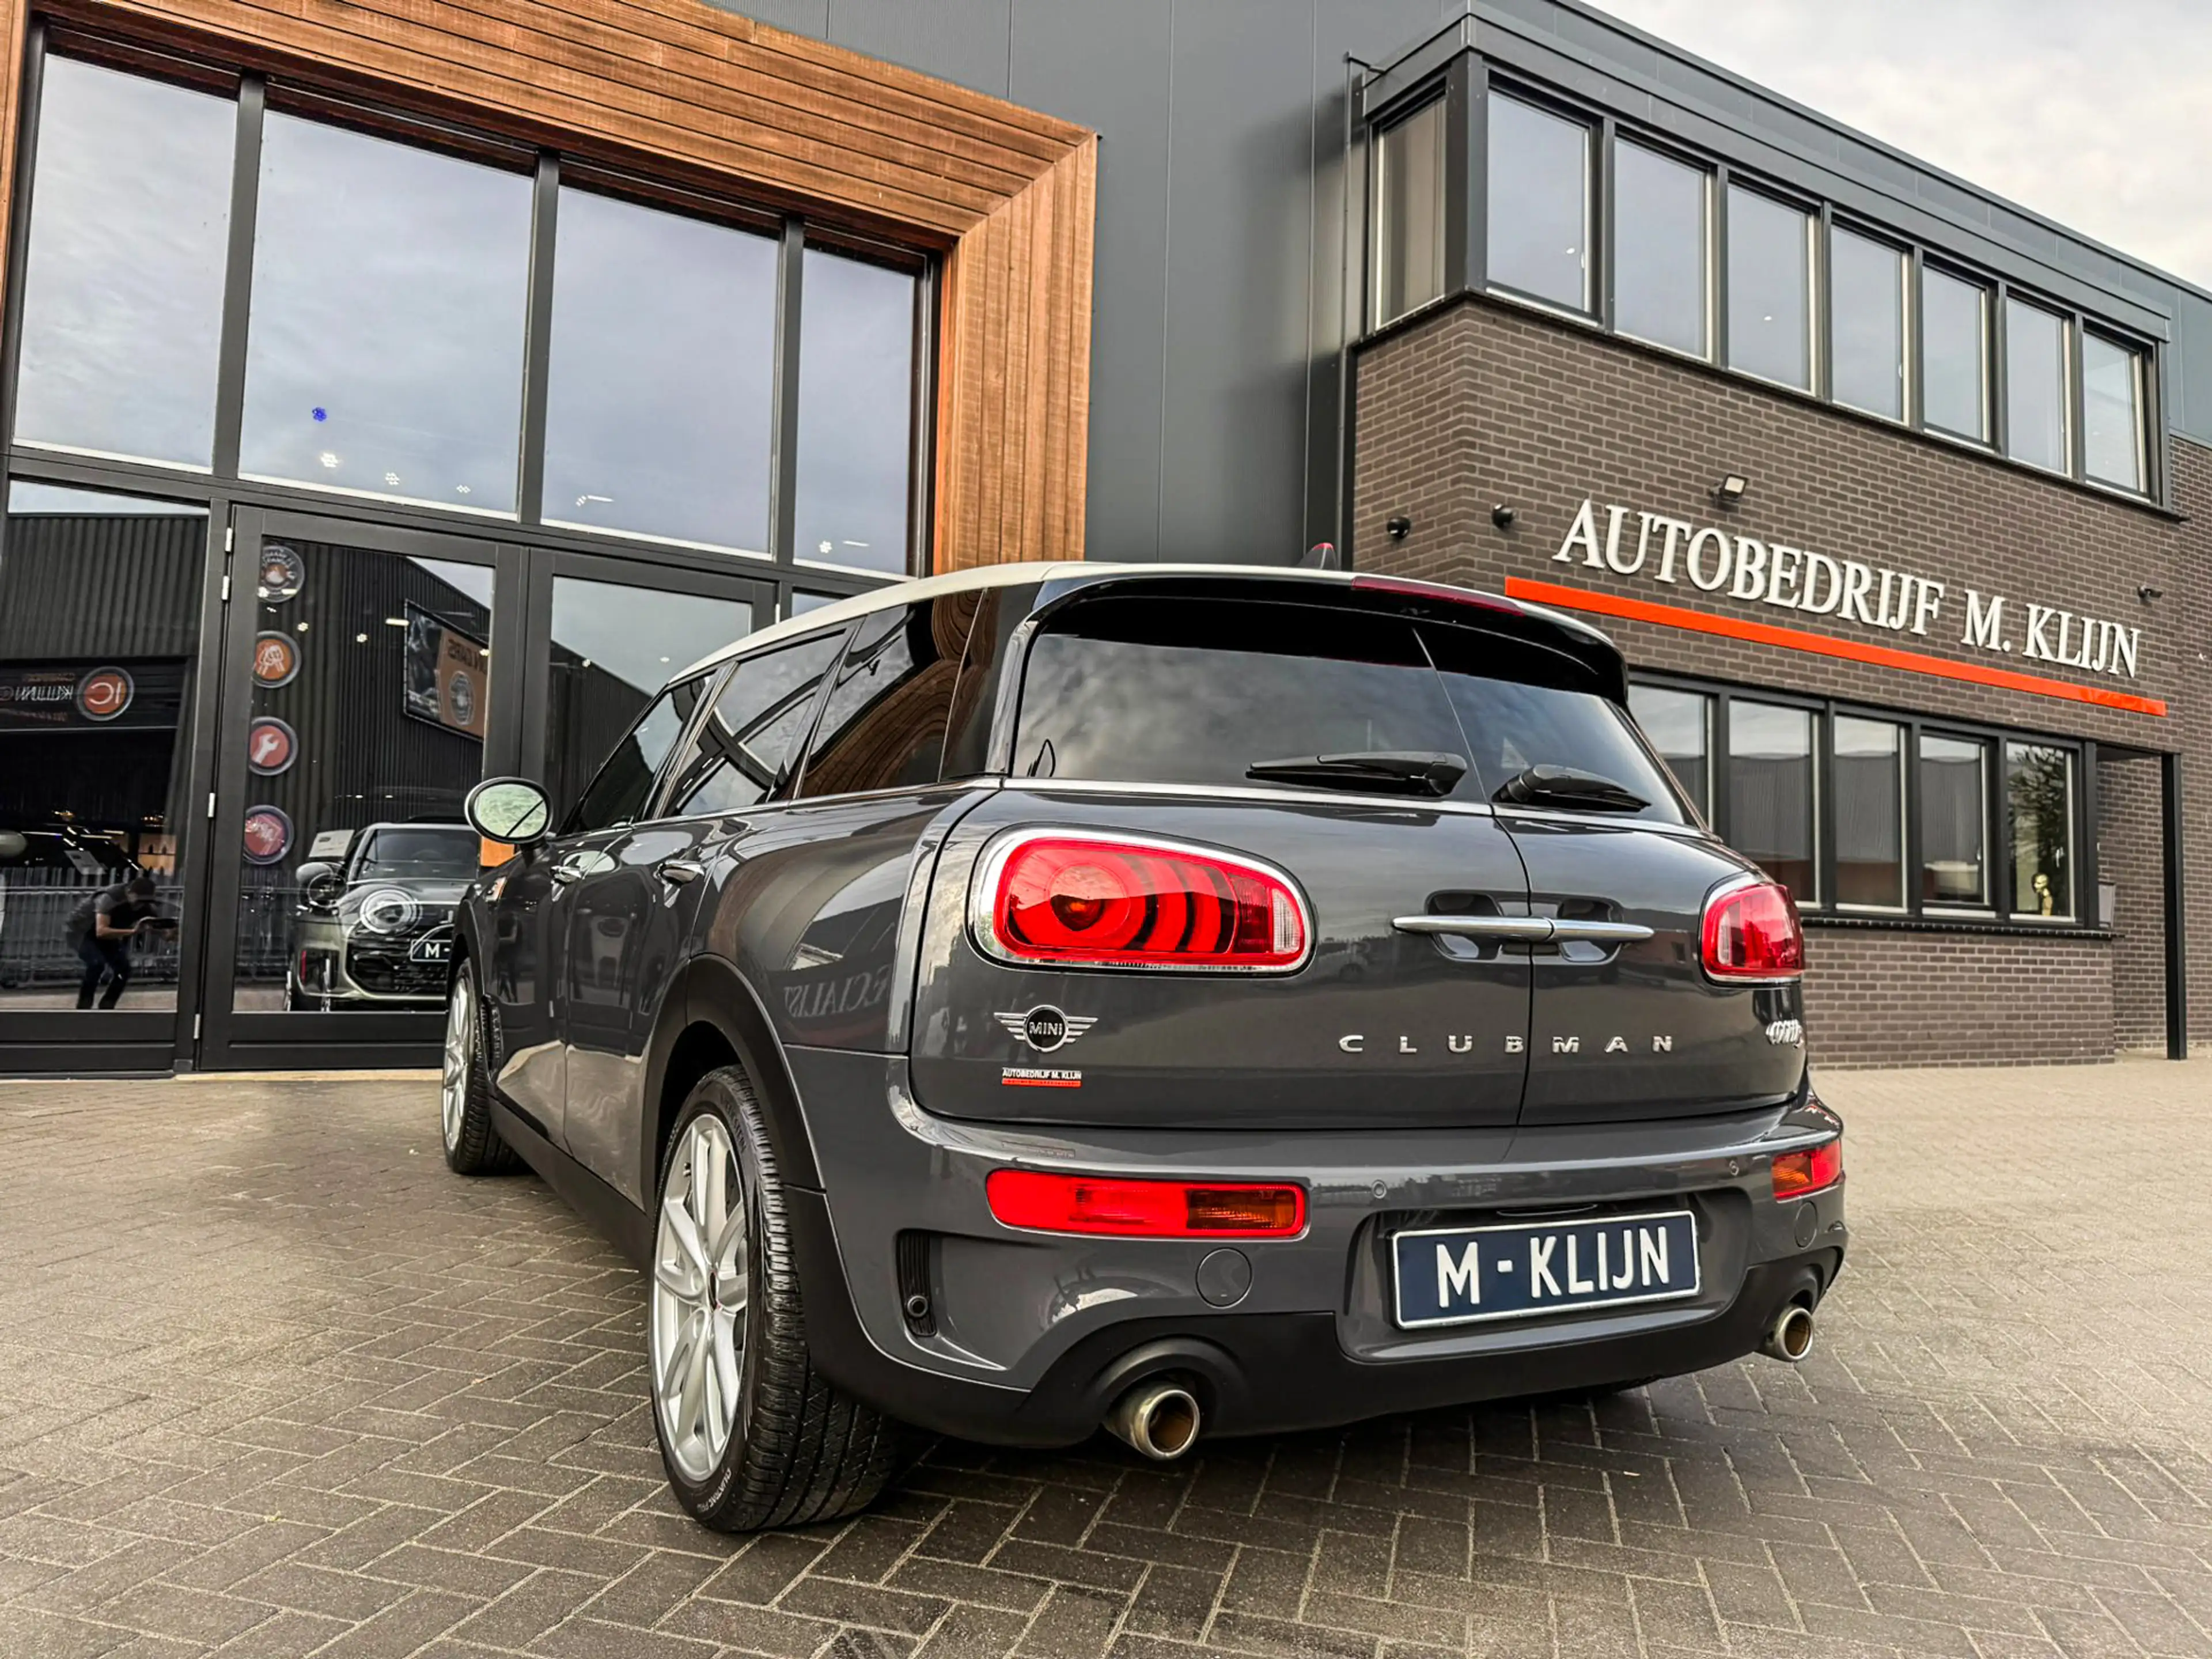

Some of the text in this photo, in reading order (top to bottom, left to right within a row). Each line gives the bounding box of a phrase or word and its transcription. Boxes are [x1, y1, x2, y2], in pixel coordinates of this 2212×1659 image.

[1551, 498, 2143, 679] AUTOBEDRIJF M. KLIJN
[1029, 1021, 1063, 1036] MINI
[1338, 1034, 1673, 1054] CLUBMAN
